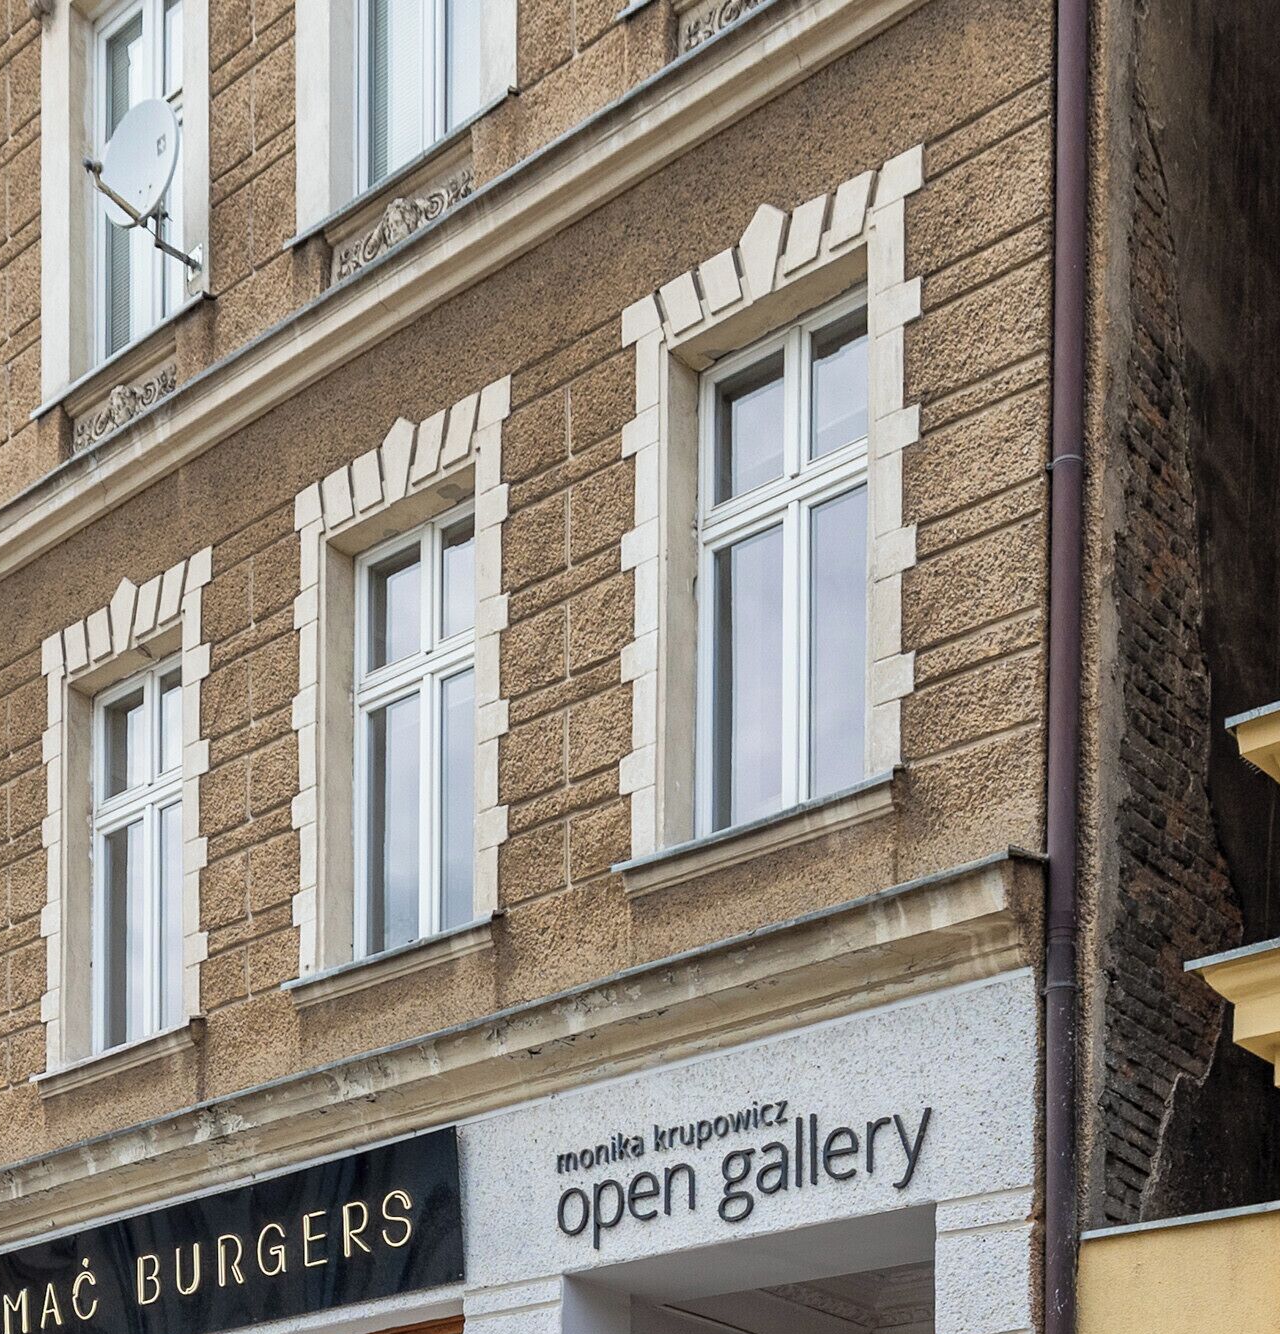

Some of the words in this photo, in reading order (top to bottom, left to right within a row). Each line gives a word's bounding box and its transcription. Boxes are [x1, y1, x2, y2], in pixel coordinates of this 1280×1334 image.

[556, 1133, 644, 1174] monika
[654, 1100, 788, 1150] krupowicz
[557, 1162, 696, 1250] open
[718, 1107, 932, 1222] gallery
[137, 1190, 412, 1305] BURGERS
